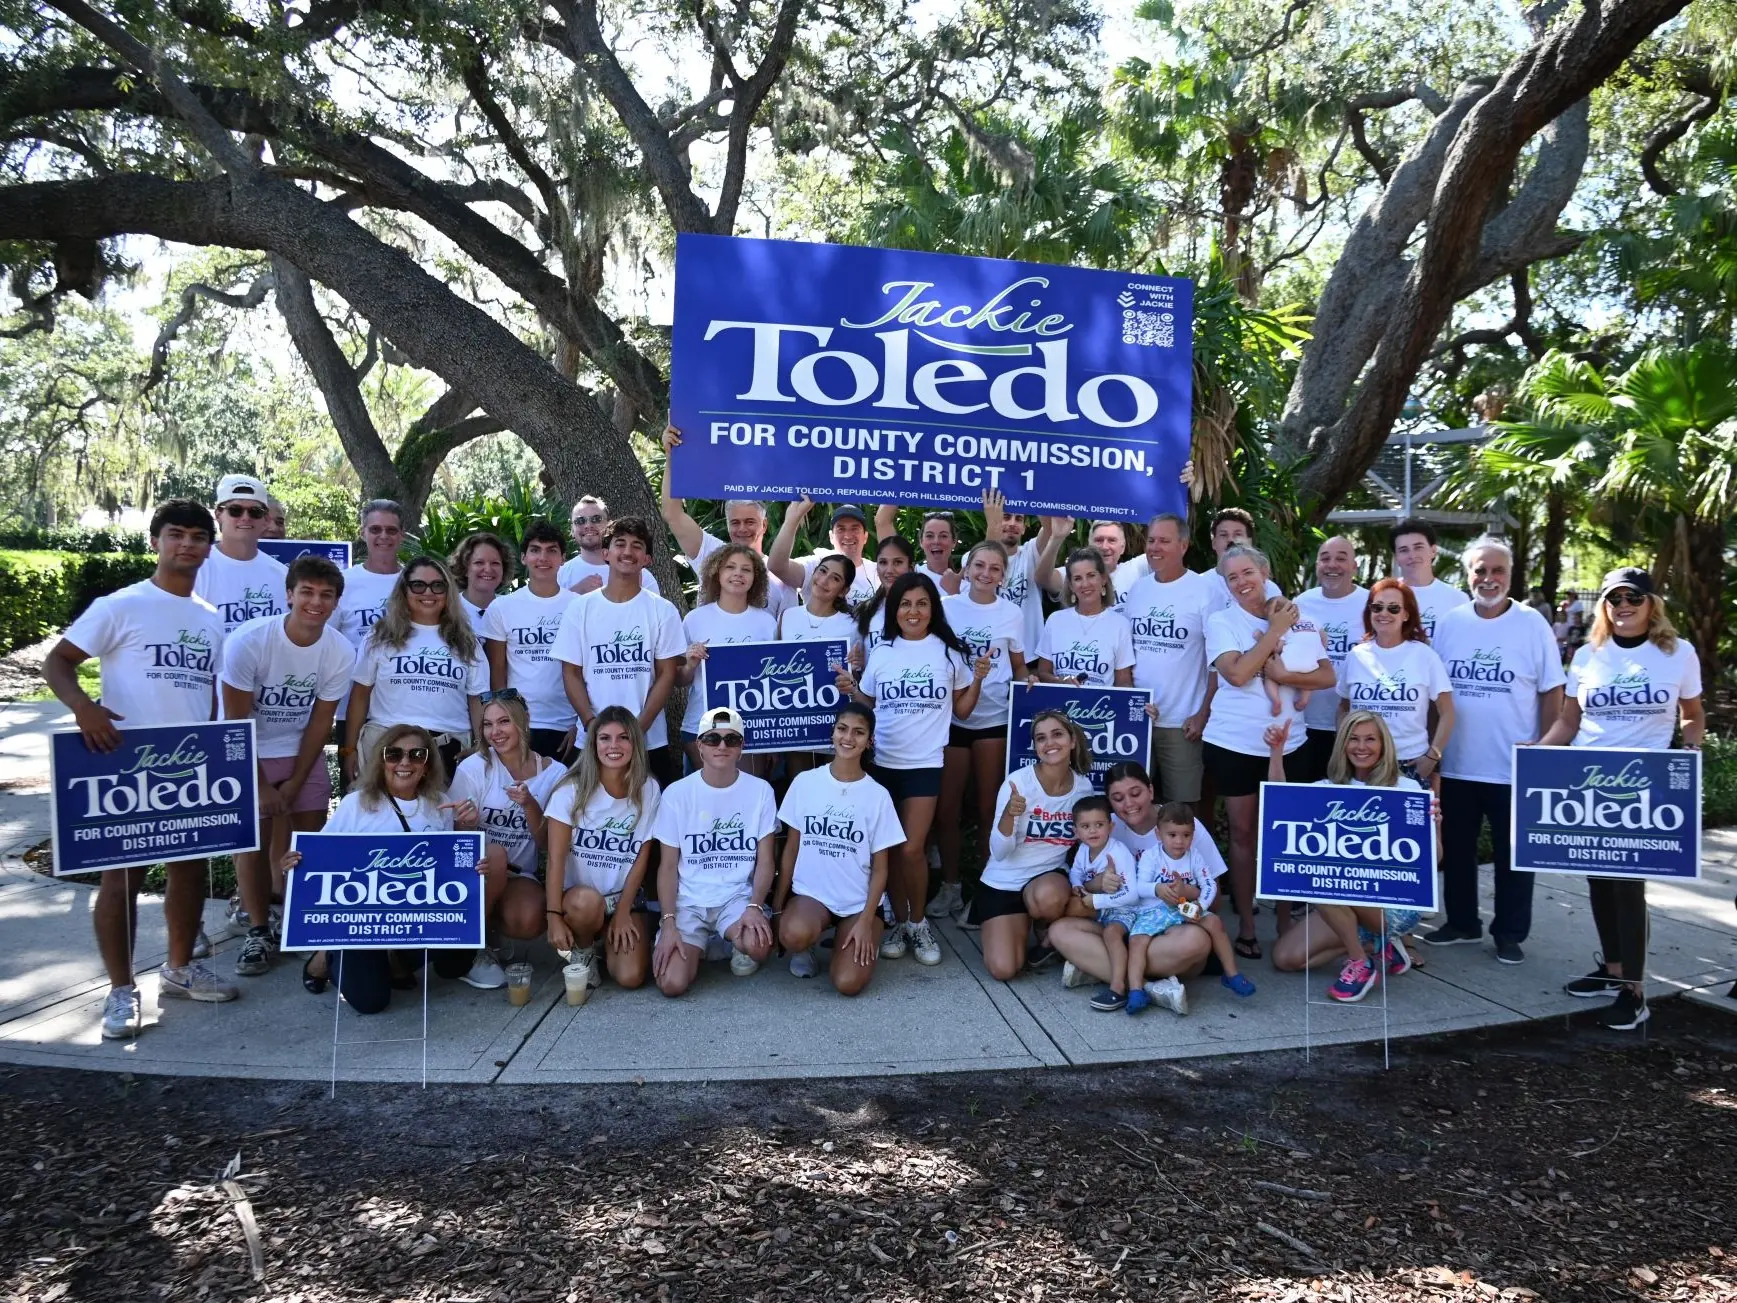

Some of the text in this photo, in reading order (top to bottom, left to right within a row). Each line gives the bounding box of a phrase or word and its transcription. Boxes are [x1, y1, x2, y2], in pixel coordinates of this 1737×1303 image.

[1127, 282, 1174, 293] CONNECT
[1149, 292, 1174, 301] WITH
[840, 276, 1074, 336] Jackie
[1139, 300, 1174, 309] JACKIE
[703, 319, 1159, 428] Toledo
[710, 422, 1154, 477] FOR COUNTY COMMISSION,
[832, 456, 1035, 491] DISTRICT 1
[723, 484, 745, 492] PAID
[746, 485, 760, 493] BY
[760, 485, 793, 494] JACKIE
[795, 486, 835, 497] TOLEDO,
[836, 487, 898, 499] REPUBLICAN,
[899, 490, 919, 499] FOR
[920, 492, 984, 504] HILLSBOROUG
[1029, 500, 1089, 513] COMMISSION,
[1090, 505, 1129, 515] DISTRICT
[1130, 508, 1138, 516] 1.
[239, 583, 274, 602] Jackie
[1142, 604, 1176, 619] Jackie
[172, 628, 212, 647] Jackie
[511, 626, 557, 645] Tole
[608, 625, 644, 645] Jackie
[1130, 617, 1189, 640] Toledo
[1065, 639, 1101, 654] Jackie
[1466, 646, 1502, 662] Jackie
[389, 655, 464, 680] Toledo
[750, 648, 815, 680] Jackie
[894, 663, 935, 681] Jackie
[1051, 651, 1109, 675] Toledo
[1448, 659, 1516, 684] Toledo
[146, 672, 162, 680] FOR
[275, 672, 317, 688] Jacki
[389, 678, 402, 686] FOR
[402, 678, 427, 686] COUNTY
[257, 684, 316, 708] Toled
[410, 685, 440, 694] DISTRICT
[715, 672, 840, 712] Toledo
[877, 678, 947, 701] Toledo
[1354, 682, 1419, 701] Toledo
[1585, 682, 1670, 708] Toledo
[1065, 695, 1117, 720] Jackie
[753, 728, 808, 740] DISTRICT 1
[120, 733, 209, 775] Jackie
[1569, 758, 1652, 790] Jackie
[68, 763, 242, 818] Toledo
[816, 803, 856, 820] Jackie
[1313, 795, 1391, 823] Jackie
[1525, 787, 1685, 831] Toledo
[74, 812, 242, 842] FOR COUNTY COMMISSION,
[596, 814, 636, 831] Jacki
[706, 812, 746, 834] Jackie
[803, 815, 864, 844] Toledo
[1026, 820, 1076, 839] LYSS
[122, 831, 199, 851] DISTRICT 1
[684, 828, 758, 855] Toledo
[1271, 820, 1421, 864] Toledo
[1528, 832, 1683, 854] FOR COUNTY COMMISSION,
[353, 840, 438, 872] Jackie
[580, 852, 605, 861] COUNTY
[586, 860, 617, 870] DISTRICT
[698, 855, 719, 865] COUNTY
[1568, 848, 1639, 862] DISTRICT 1
[703, 862, 733, 870] DISTRICT
[1273, 862, 1420, 885] FOR COUNTY COMMISSION,
[303, 867, 469, 906] Toledo
[1312, 876, 1380, 892] DISTRICT 1
[303, 912, 467, 925] FOR COUNTY COMMISSION,
[348, 924, 424, 935] DISTRICT 1
